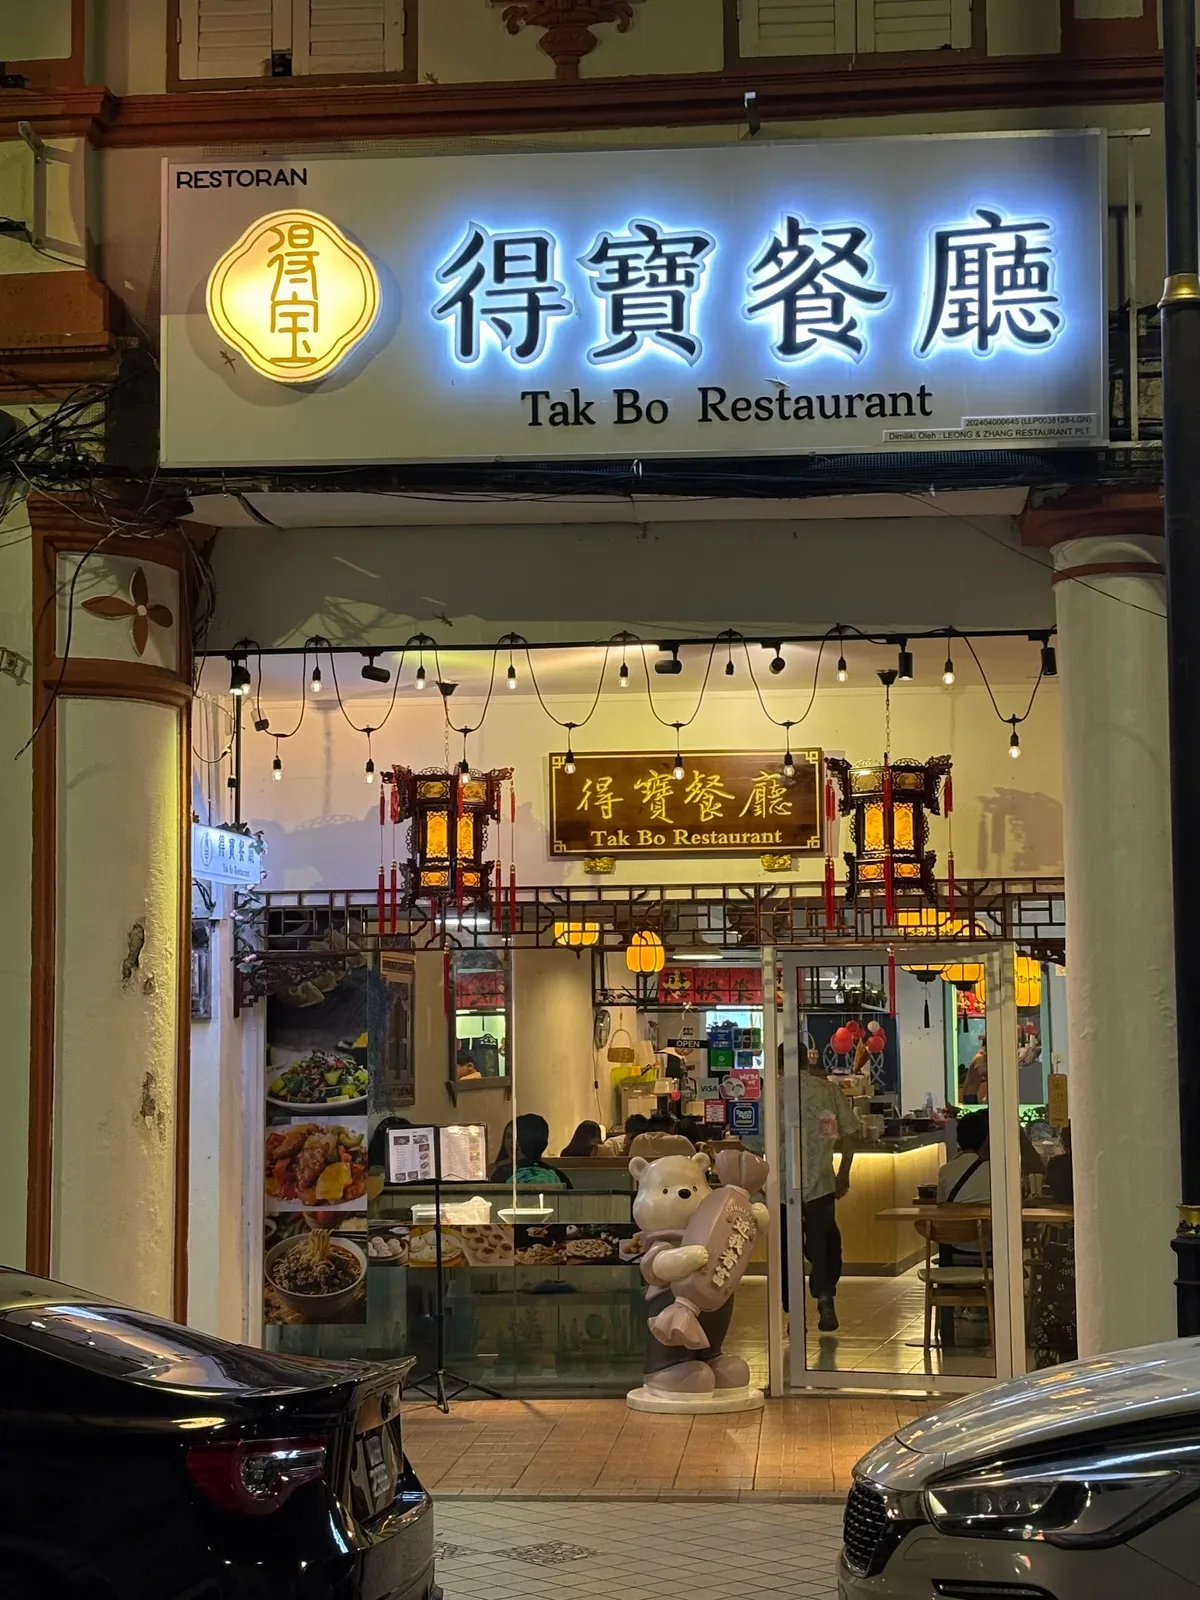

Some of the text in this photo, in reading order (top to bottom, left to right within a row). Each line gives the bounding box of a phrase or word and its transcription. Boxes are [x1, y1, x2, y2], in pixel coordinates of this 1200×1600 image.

[176, 167, 308, 190] RESTORAN
[267, 223, 321, 364] 得宝
[433, 208, 1063, 365] 得寶餐廳
[521, 384, 934, 427] Tak Bo Restaurant
[917, 431, 937, 439] Oleh
[942, 429, 974, 439] LEONG
[975, 429, 982, 438] &
[983, 429, 1014, 438] ZHANG
[1015, 427, 1073, 437] RESTAURANT
[1074, 426, 1091, 435] PLT
[576, 769, 793, 824] 得寶餐廳
[590, 828, 783, 847] Tak Bo Restaurant
[676, 1040, 700, 1048] OPEN
[734, 1035, 759, 1043] JCB
